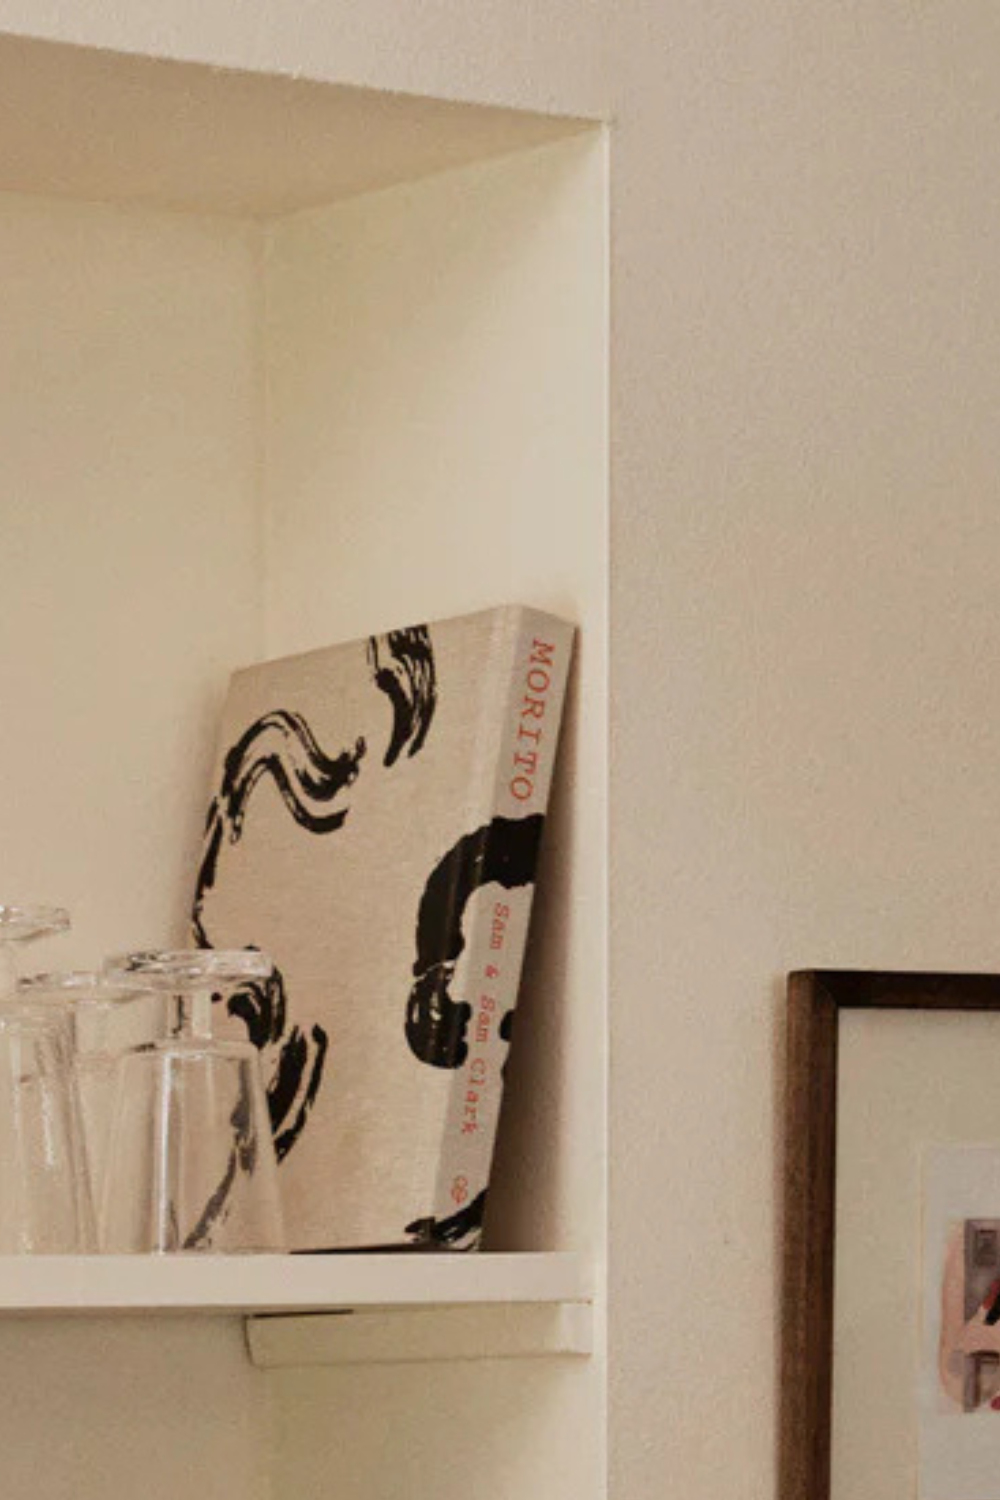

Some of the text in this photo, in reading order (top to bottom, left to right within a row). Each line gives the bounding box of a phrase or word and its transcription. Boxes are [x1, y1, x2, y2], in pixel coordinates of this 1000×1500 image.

[509, 637, 555, 802] MORITO
[489, 902, 510, 950] Sam
[474, 995, 495, 1042] Sam
[461, 1057, 486, 1136] Clark
